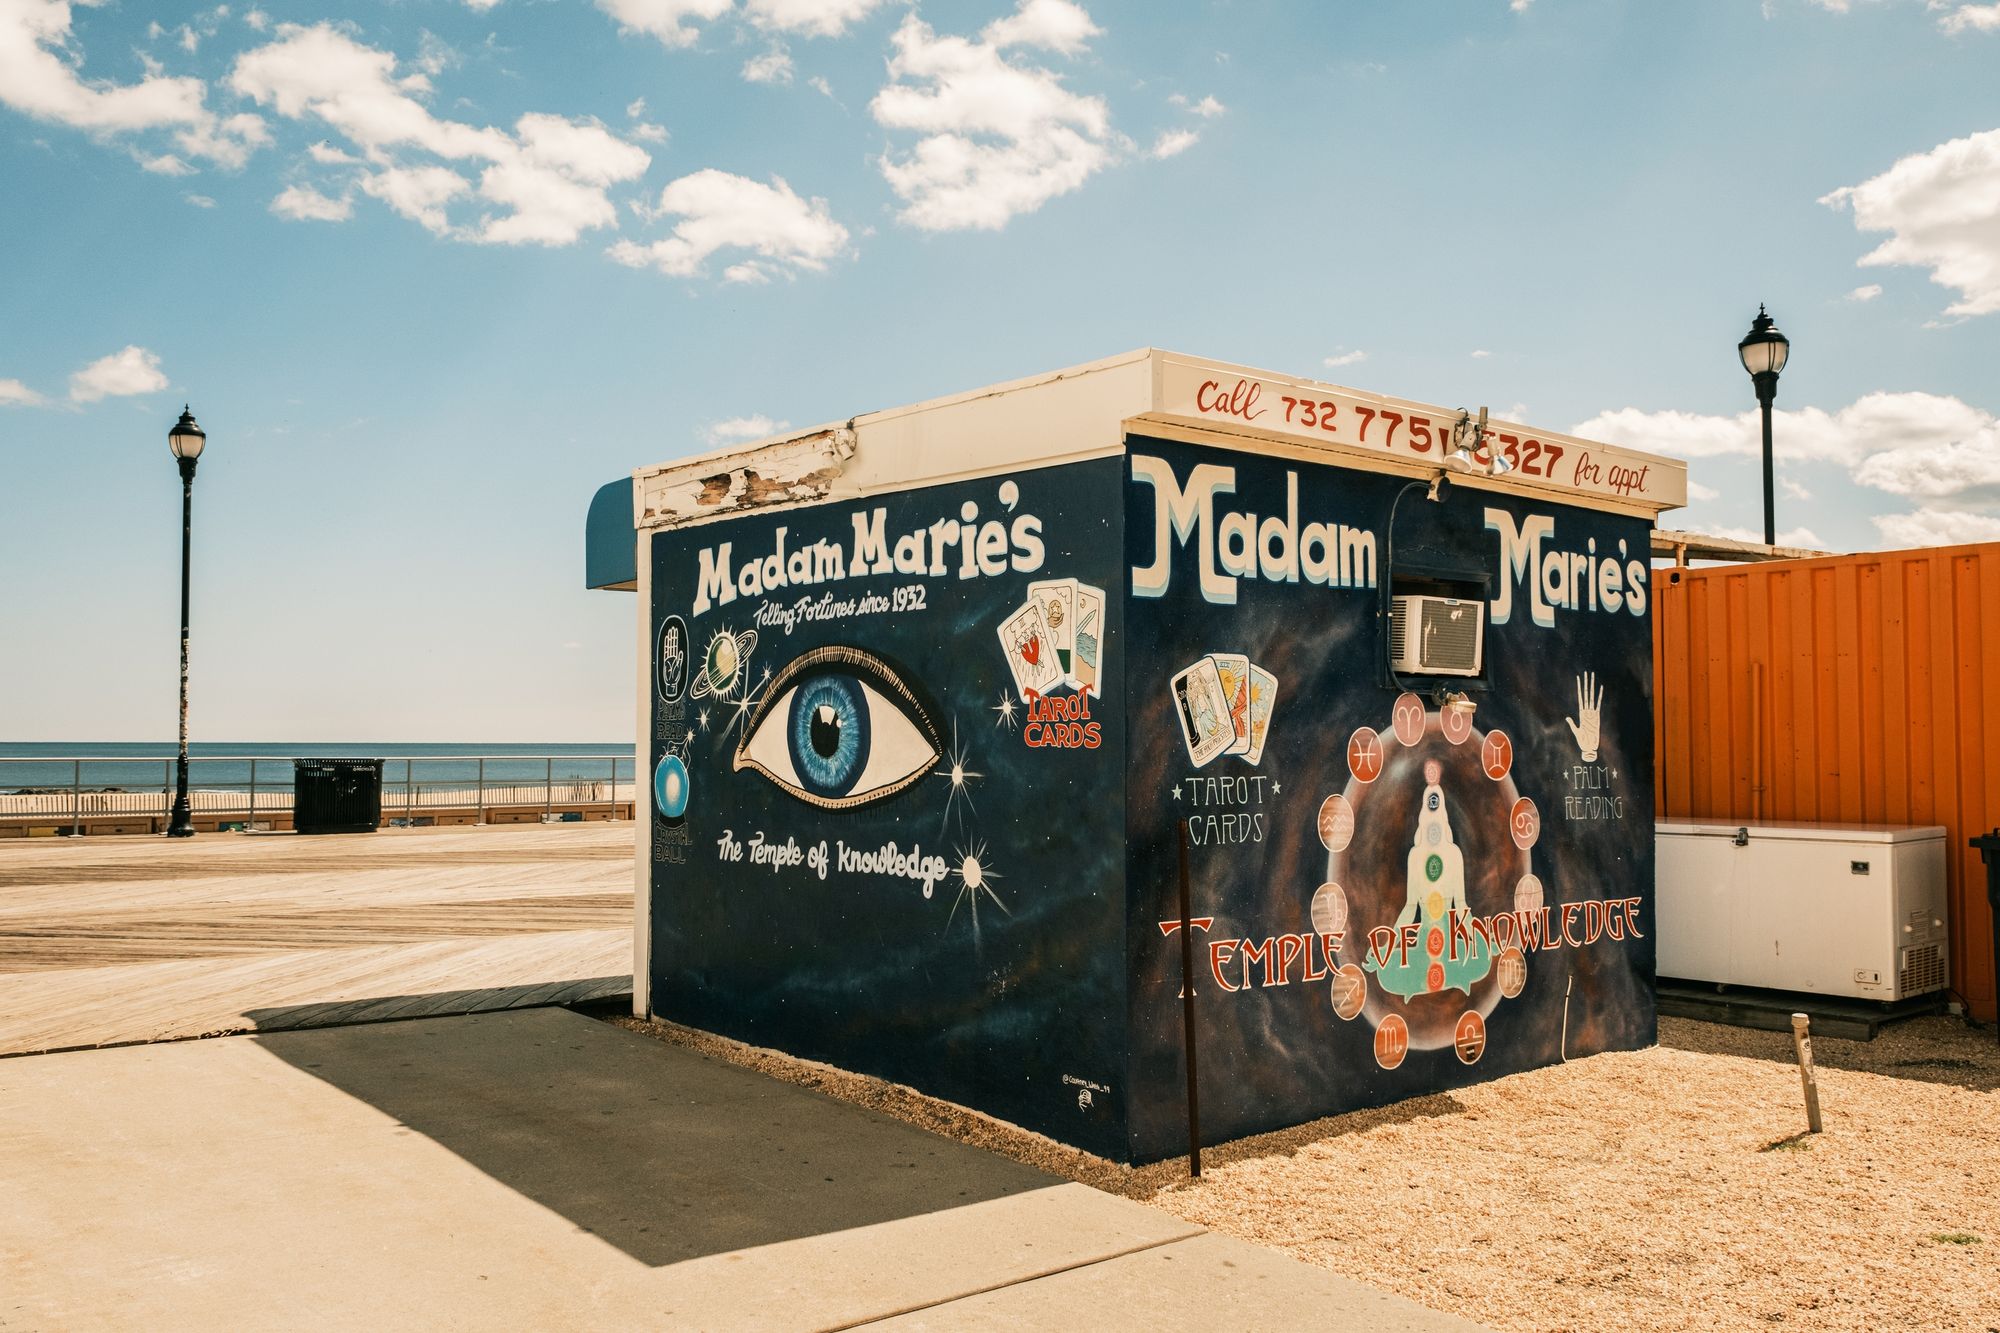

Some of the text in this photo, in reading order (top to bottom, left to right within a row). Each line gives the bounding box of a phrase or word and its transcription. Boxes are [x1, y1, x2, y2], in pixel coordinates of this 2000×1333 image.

[1197, 379, 1267, 421] Call
[1281, 396, 1336, 432] 732
[1355, 407, 1432, 453] 775
[1574, 451, 1603, 487] for
[693, 480, 1046, 617] Madam Marie's
[1131, 454, 1646, 628] Madam Marie's
[753, 584, 927, 636] Telling Fortunes since 1932
[1024, 683, 1094, 723] TAROT
[1024, 722, 1101, 749] CARDS
[1186, 776, 1267, 805] TAROT
[1573, 766, 1609, 789] PALM
[1565, 795, 1623, 820] READING
[1188, 813, 1264, 845] CARDS
[655, 844, 687, 865] BALL
[717, 829, 949, 899] The Temple of Knowledge
[1367, 923, 1422, 969] OF
[1447, 896, 1645, 966] KNOWLEDGE
